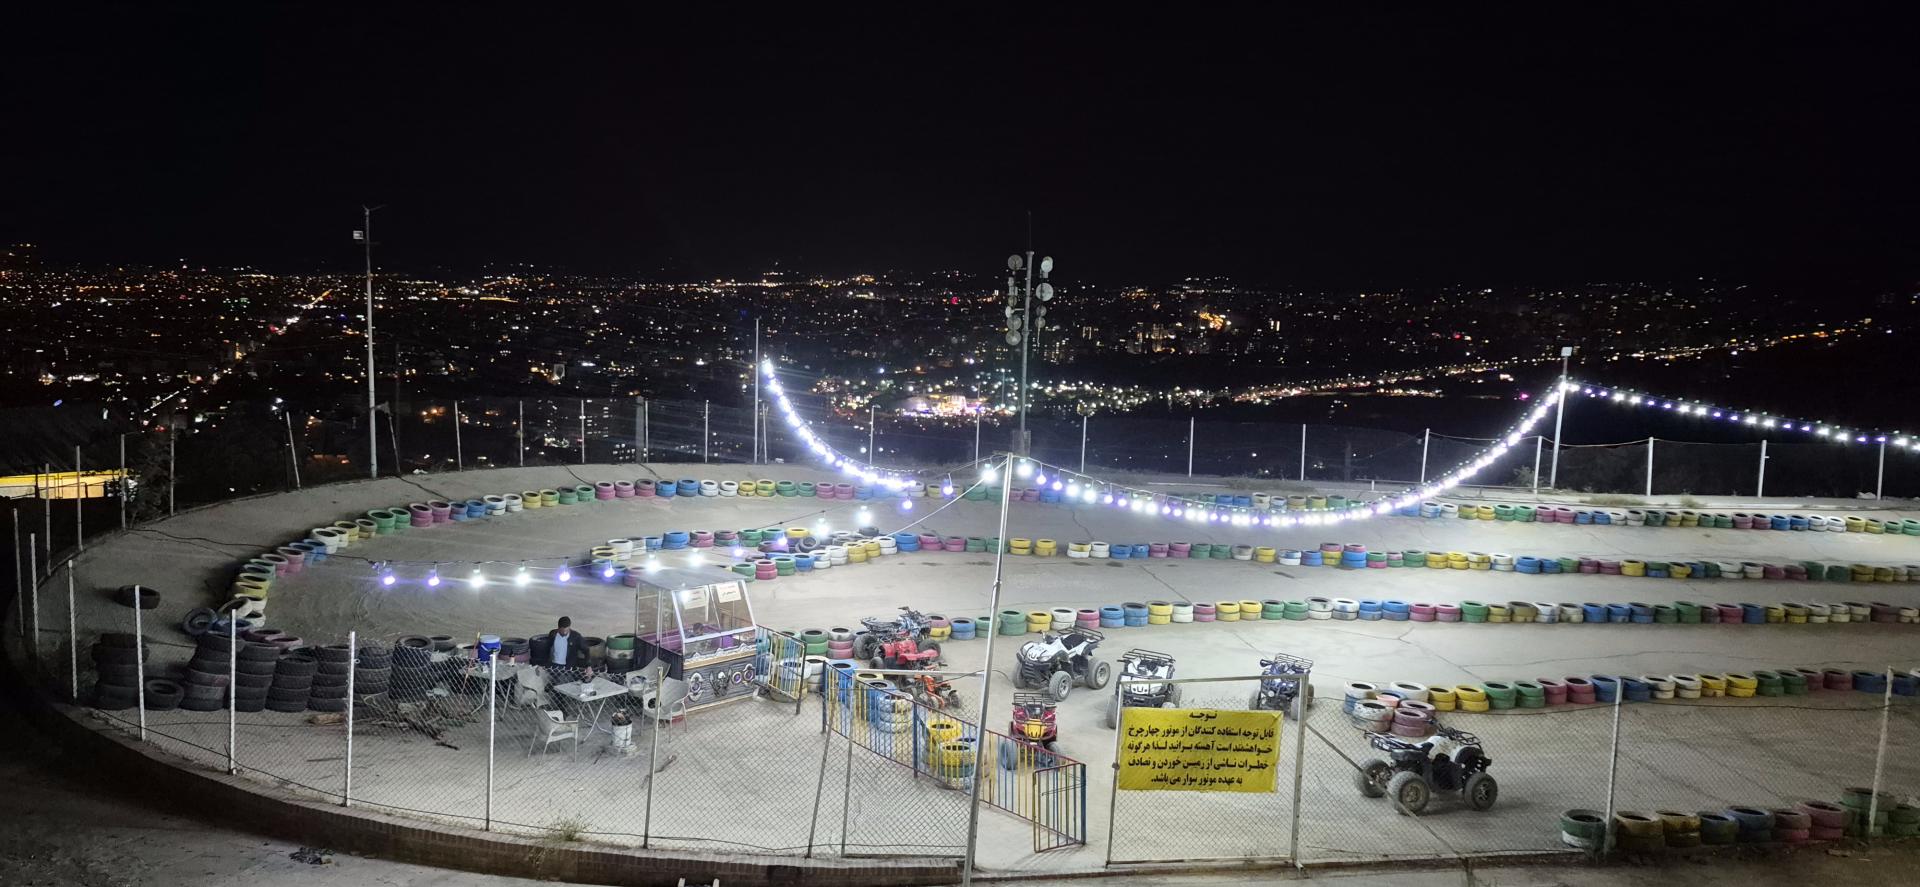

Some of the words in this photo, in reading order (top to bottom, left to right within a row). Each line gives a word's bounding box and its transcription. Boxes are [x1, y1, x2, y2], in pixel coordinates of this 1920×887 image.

[1189, 710, 1218, 722] توجه
[1162, 724, 1180, 738] موتور
[1180, 724, 1188, 737] از
[1217, 727, 1242, 737] استفاده
[1242, 728, 1259, 740] توجه
[1259, 727, 1274, 740] قابل
[1152, 740, 1168, 750] لذا
[1168, 740, 1193, 753] برانید
[1194, 740, 1216, 751] آهسته
[1216, 742, 1232, 752] است
[1128, 755, 1151, 767] تصادف
[1157, 756, 1182, 770] خوردن
[1182, 758, 1205, 770] زمین
[1205, 757, 1213, 770] از
[1213, 757, 1237, 770] ناشی
[1238, 759, 1269, 772] خطرات
[1169, 776, 1181, 785] می
[1182, 772, 1198, 786] سوار
[1197, 773, 1217, 786] موتور
[1218, 776, 1235, 786] عهده
[1235, 776, 1243, 787] به
